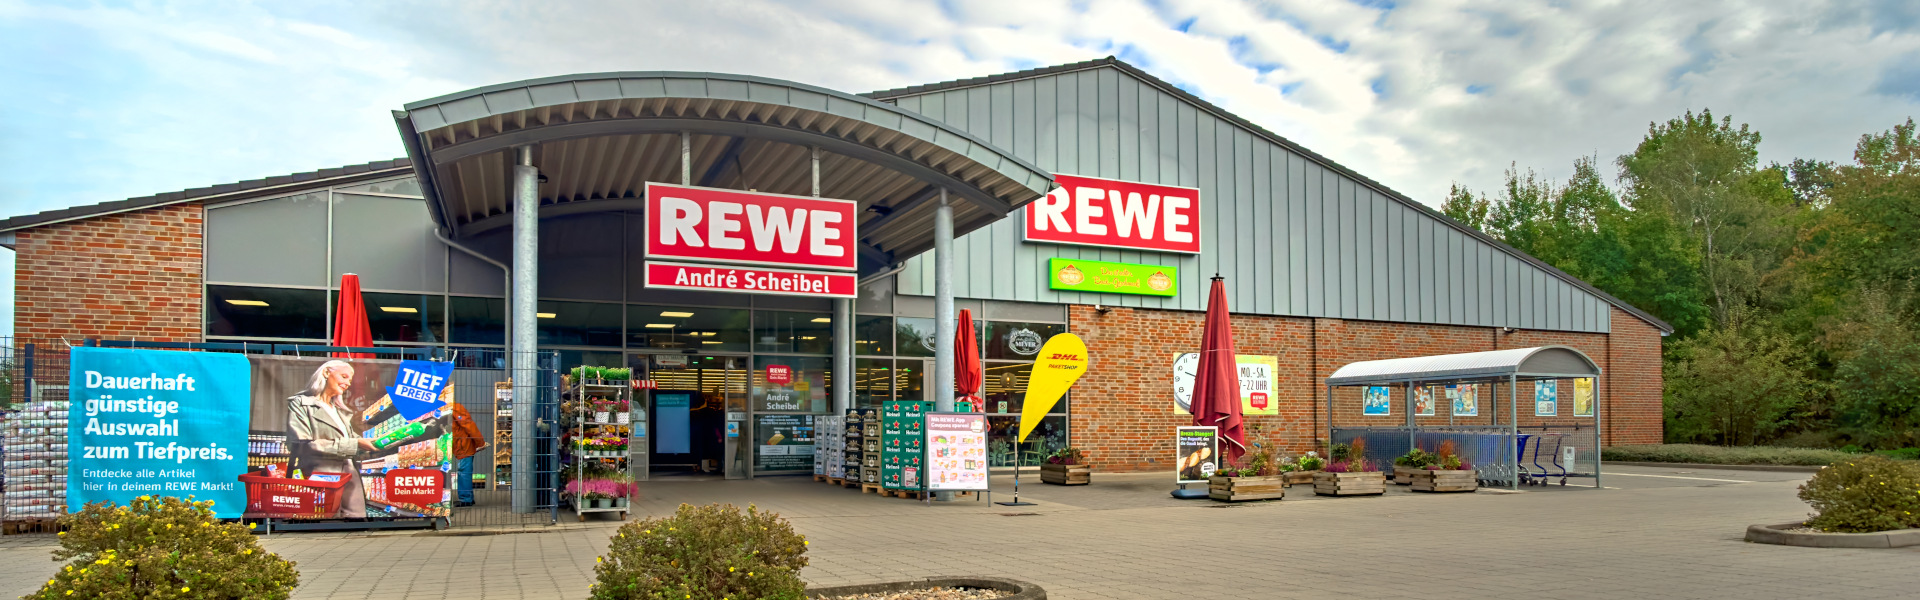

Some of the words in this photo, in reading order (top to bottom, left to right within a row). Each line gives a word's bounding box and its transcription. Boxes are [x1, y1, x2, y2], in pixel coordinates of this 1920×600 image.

[1034, 185, 1193, 243] REWE
[660, 196, 844, 257] REWE
[675, 268, 738, 288] André
[744, 272, 829, 293] Scheibel
[85, 370, 195, 392] Dauerhaft
[403, 367, 443, 391] TIEF
[1256, 380, 1268, 390] UHR
[400, 386, 432, 402] PREIS
[85, 395, 179, 418] günstige
[84, 418, 179, 436] Auswahl
[83, 445, 129, 459] zum
[134, 442, 234, 464] Tiefpreis.
[83, 469, 133, 478] Entdecke
[136, 469, 155, 478] alle
[159, 470, 195, 478] Artikel
[394, 476, 435, 486] REWE
[83, 482, 104, 491] hier
[108, 482, 118, 491] in
[122, 482, 161, 491] deinem
[165, 482, 197, 491] REWE
[201, 482, 234, 491] Markt!
[272, 496, 300, 504] REWE
